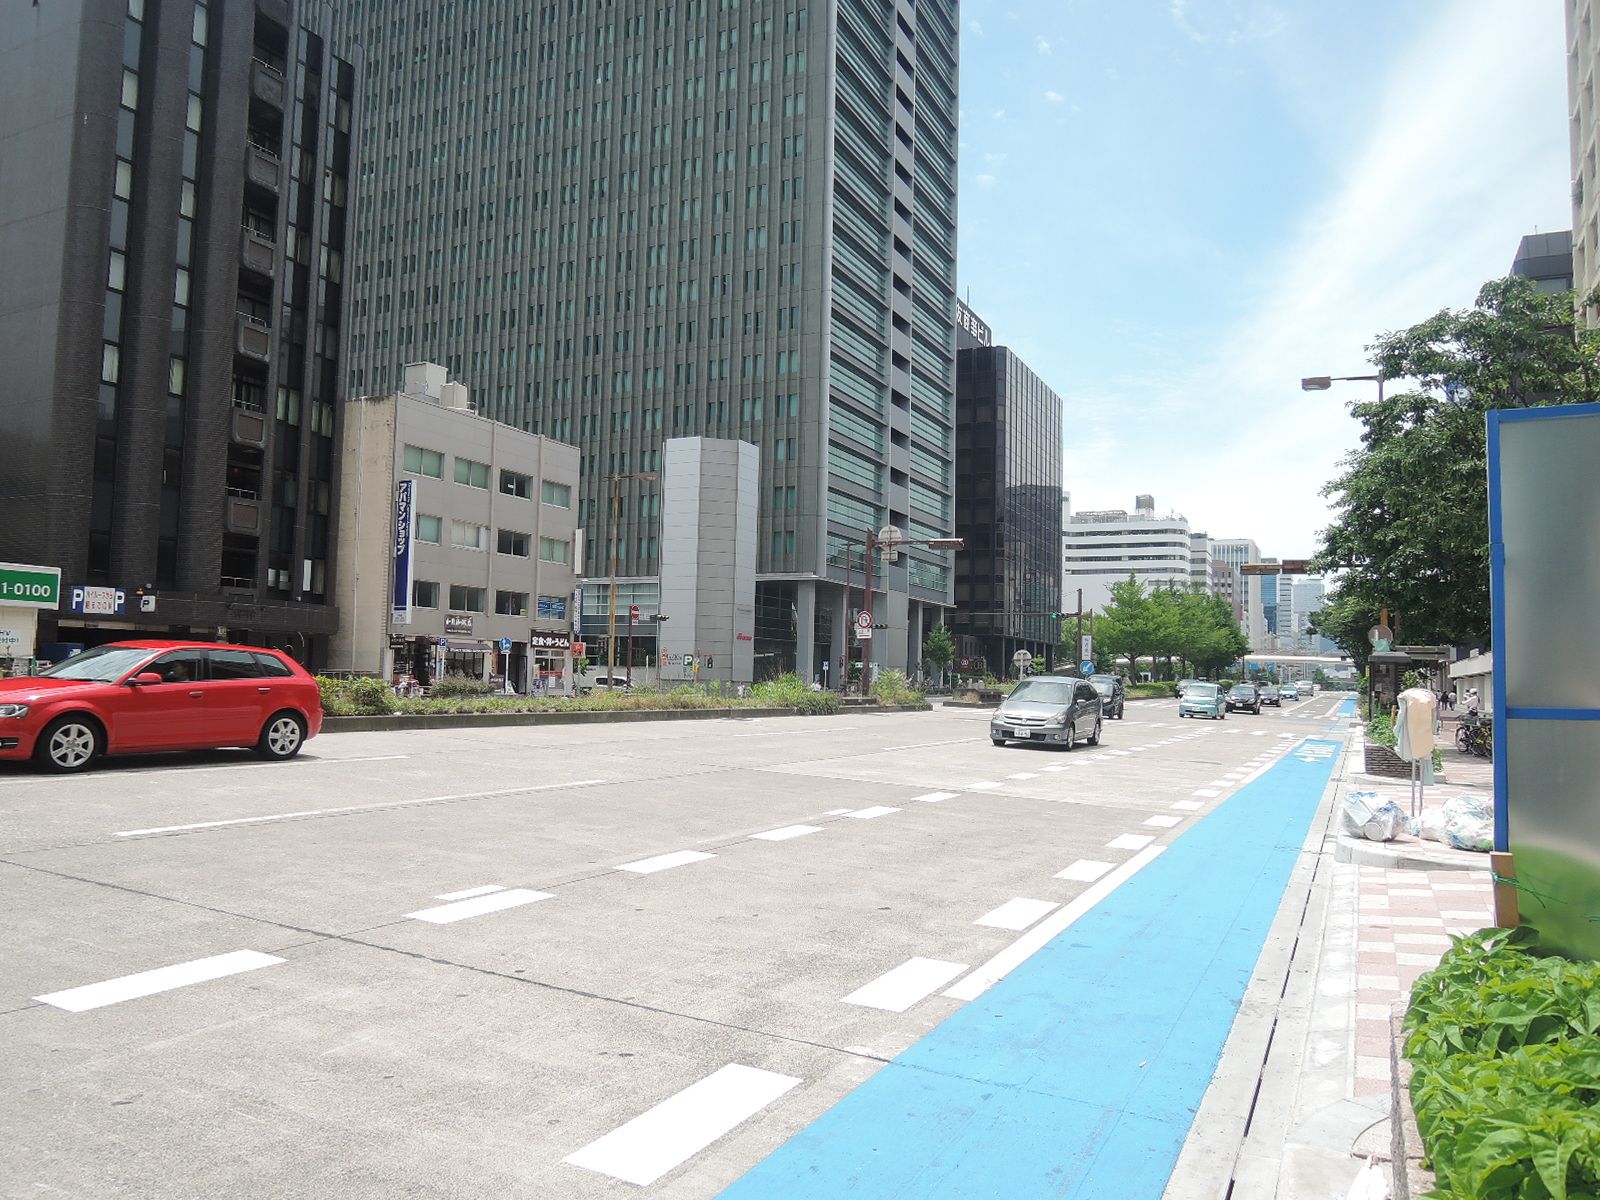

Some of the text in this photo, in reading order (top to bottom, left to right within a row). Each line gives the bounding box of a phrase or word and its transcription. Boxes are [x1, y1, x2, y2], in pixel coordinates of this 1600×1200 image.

[397, 483, 408, 556] アパマンショップ
[1, 582, 51, 597] 1-0100
[72, 589, 84, 609] P
[114, 591, 125, 611] P
[532, 636, 570, 647] 定食・丼・うどん
[684, 656, 693, 665] P
